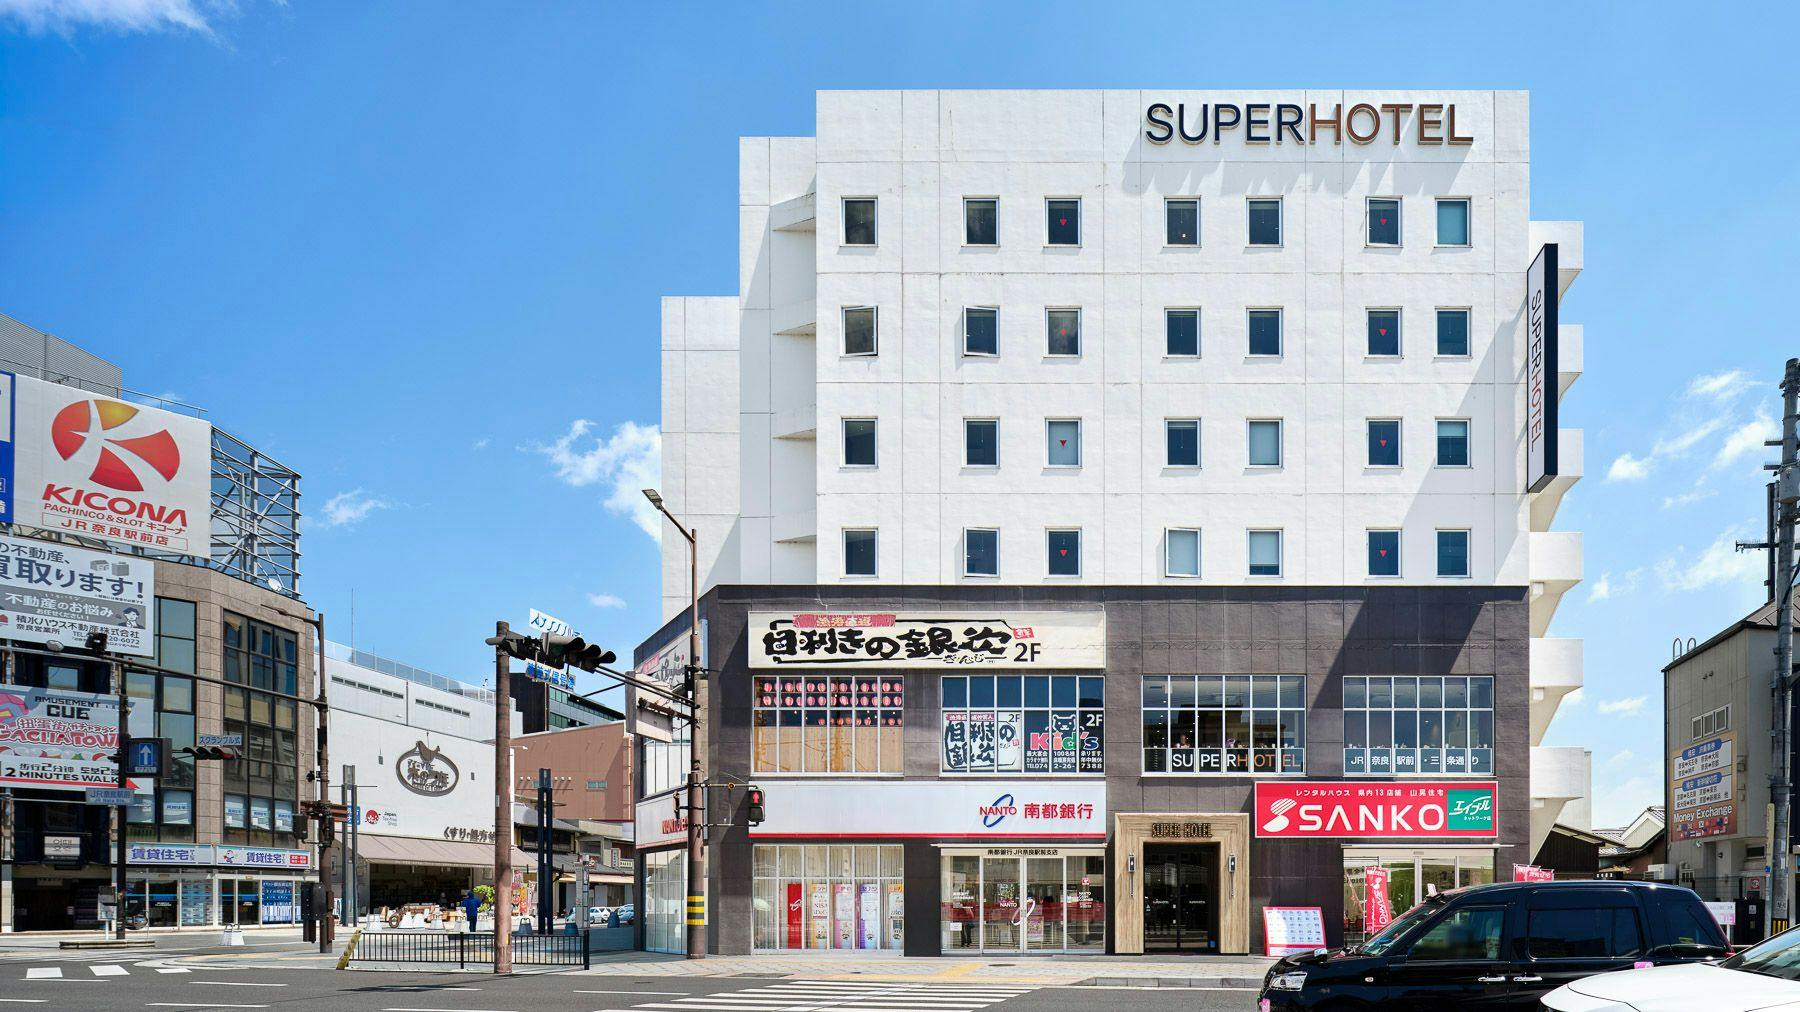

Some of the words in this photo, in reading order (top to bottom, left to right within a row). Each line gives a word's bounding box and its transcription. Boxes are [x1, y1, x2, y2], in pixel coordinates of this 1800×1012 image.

[1146, 103, 1474, 145] SUPERHOTEL
[1532, 289, 1542, 453] SUPERHOTEL
[42, 484, 187, 527] KICONA
[44, 503, 104, 520] PACHINCO
[116, 517, 144, 528] SLOT
[146, 522, 186, 535] キコーナ
[61, 519, 169, 546] JR奈良駅前店
[5, 592, 113, 617] 不動産のお悩み
[16, 615, 140, 639] 積水ハウス不動産株式会社
[16, 624, 60, 635] 奈良営業所
[763, 626, 1013, 658] 目利きの銀次
[1014, 642, 1041, 662] 2F
[35, 696, 100, 708] AMUSEMENT
[47, 705, 90, 720] CUE
[1009, 714, 1020, 722] 2F
[1086, 714, 1103, 726] 2F
[199, 736, 241, 745] スクランブル式
[1030, 731, 1099, 750] Kid's
[1172, 753, 1301, 768] SUPERHOTEL
[5, 767, 16, 777] 2
[19, 771, 79, 781] MINUTES
[81, 775, 119, 784] WALK
[1296, 789, 1351, 797] レンタルハウス
[980, 806, 1017, 816] NANTO
[1024, 803, 1093, 819] 南都銀行
[1448, 795, 1492, 815] エイブル
[1674, 812, 1695, 822] Money
[1696, 805, 1732, 819] Exchange
[1299, 804, 1445, 831] SANKO
[1152, 823, 1181, 838] SUPER
[1183, 823, 1213, 838] HOTEL
[131, 848, 189, 861] 賃貸住宅
[246, 852, 282, 864] 賃貸住宅
